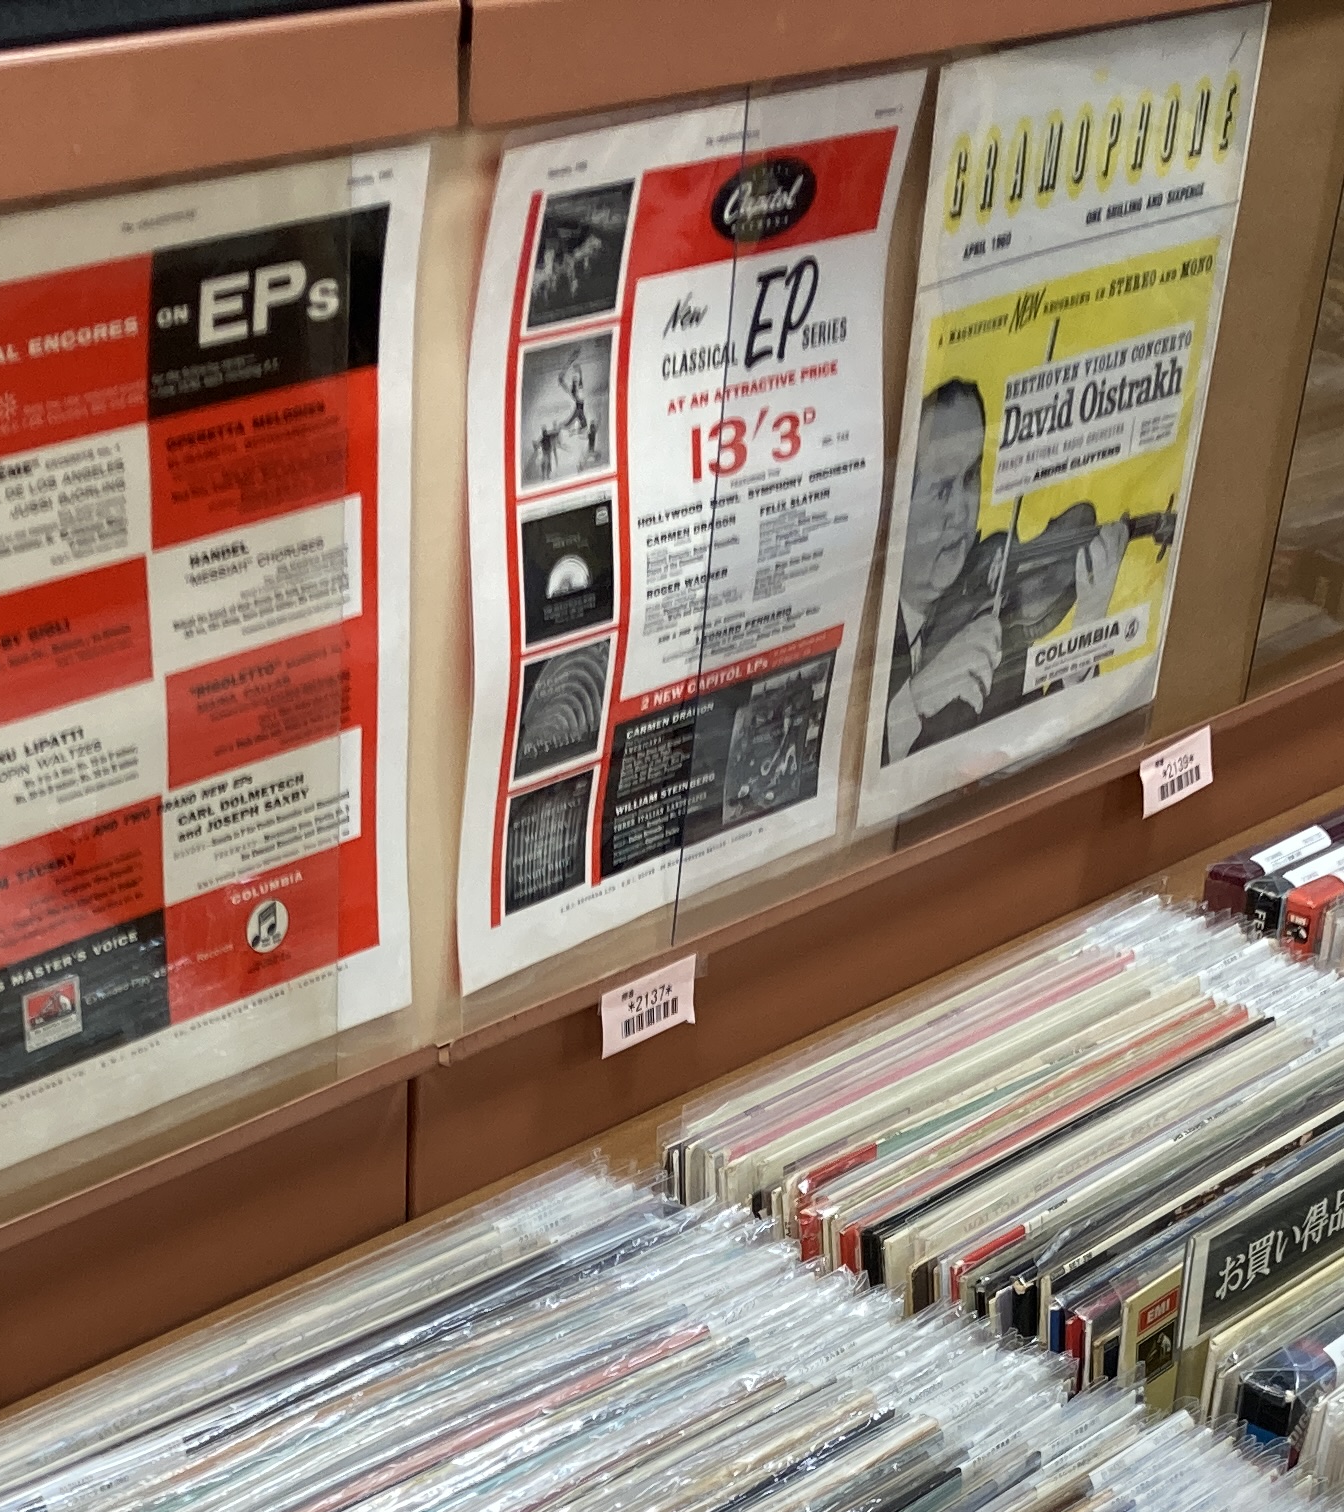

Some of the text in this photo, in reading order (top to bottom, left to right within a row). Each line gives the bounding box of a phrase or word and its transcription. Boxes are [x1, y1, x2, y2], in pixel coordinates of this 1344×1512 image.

[947, 82, 1239, 221] GRAMOPHONE
[156, 258, 341, 350] ON EPs
[744, 254, 820, 370] EP
[1008, 285, 1047, 336] NEW
[27, 315, 140, 360] ENCORES
[661, 316, 848, 381] CLASSICAL SERIES
[799, 359, 838, 381] PRICE
[1005, 328, 1193, 402] BEETHOVEN VIOLIN CONCERTO
[999, 386, 1076, 452] David
[1078, 355, 1184, 425] Oistrakh
[637, 503, 704, 530] HOLLYWOOD
[1034, 620, 1121, 669] COLUMBIA
[652, 685, 684, 708] NEW
[177, 802, 216, 828] CARL
[206, 806, 260, 834] JOSEPH
[230, 869, 304, 906] COLUMBIA
[10, 950, 88, 989] MASTER'S
[91, 927, 140, 957] VOICE
